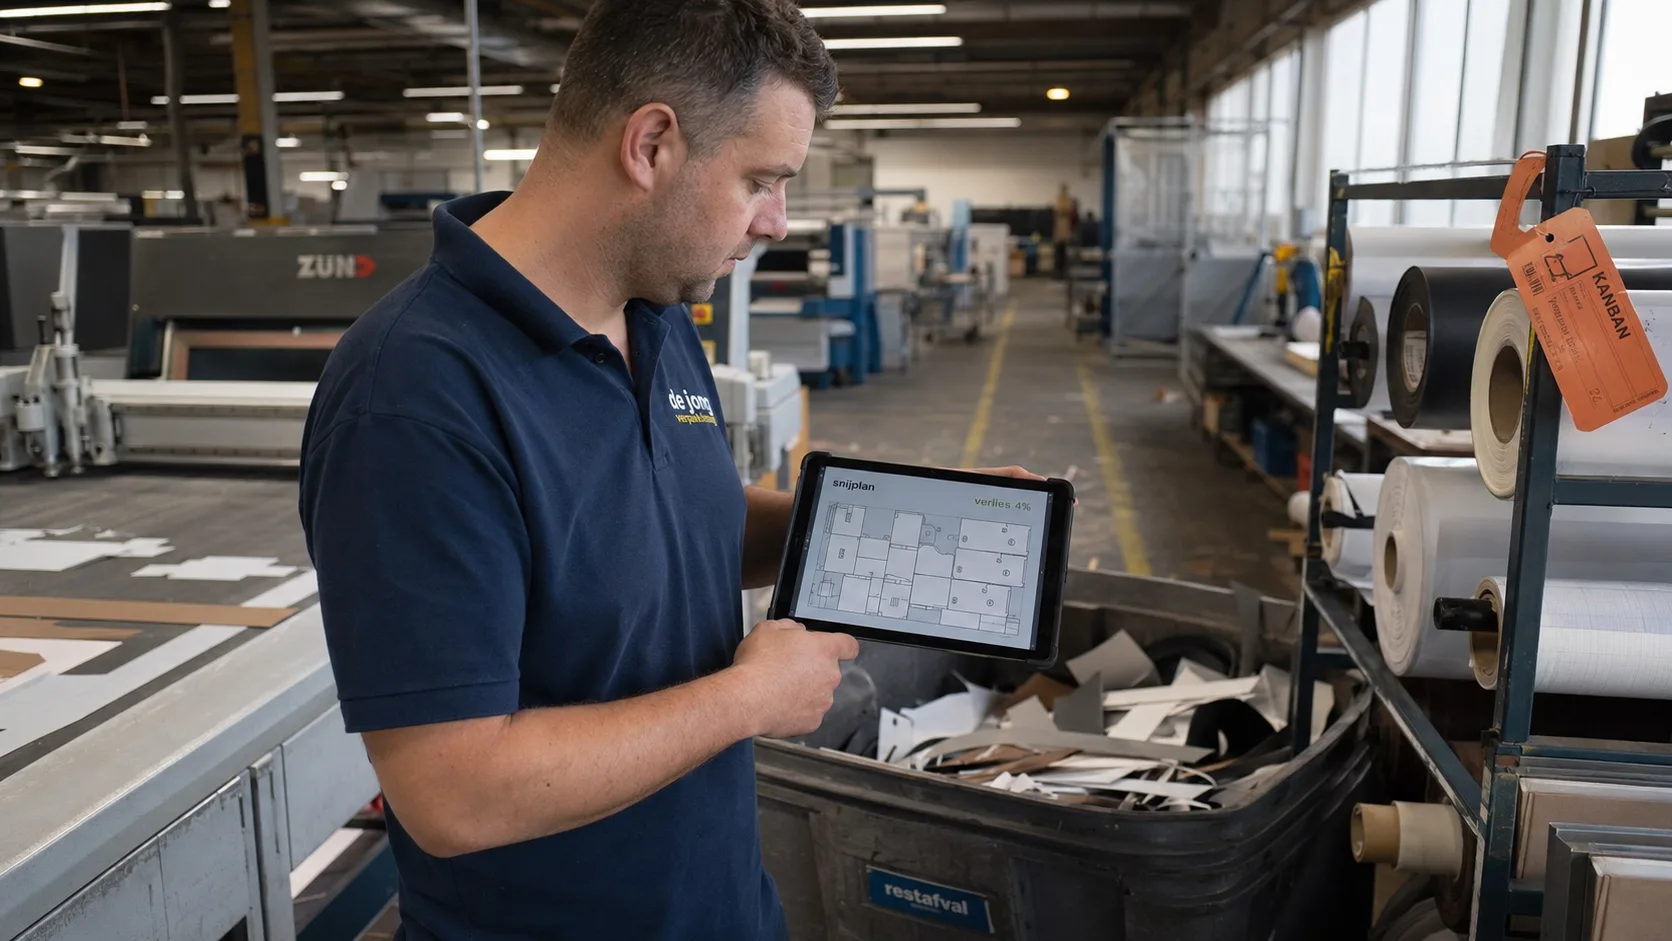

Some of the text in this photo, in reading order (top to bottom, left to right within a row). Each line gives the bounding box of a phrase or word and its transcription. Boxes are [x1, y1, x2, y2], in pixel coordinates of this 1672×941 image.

[1591, 270, 1631, 340] KANBAN
[668, 389, 714, 417] de jong
[832, 479, 875, 491] snijplan
[974, 498, 1032, 511] verlies 4%
[884, 883, 969, 915] restafval
